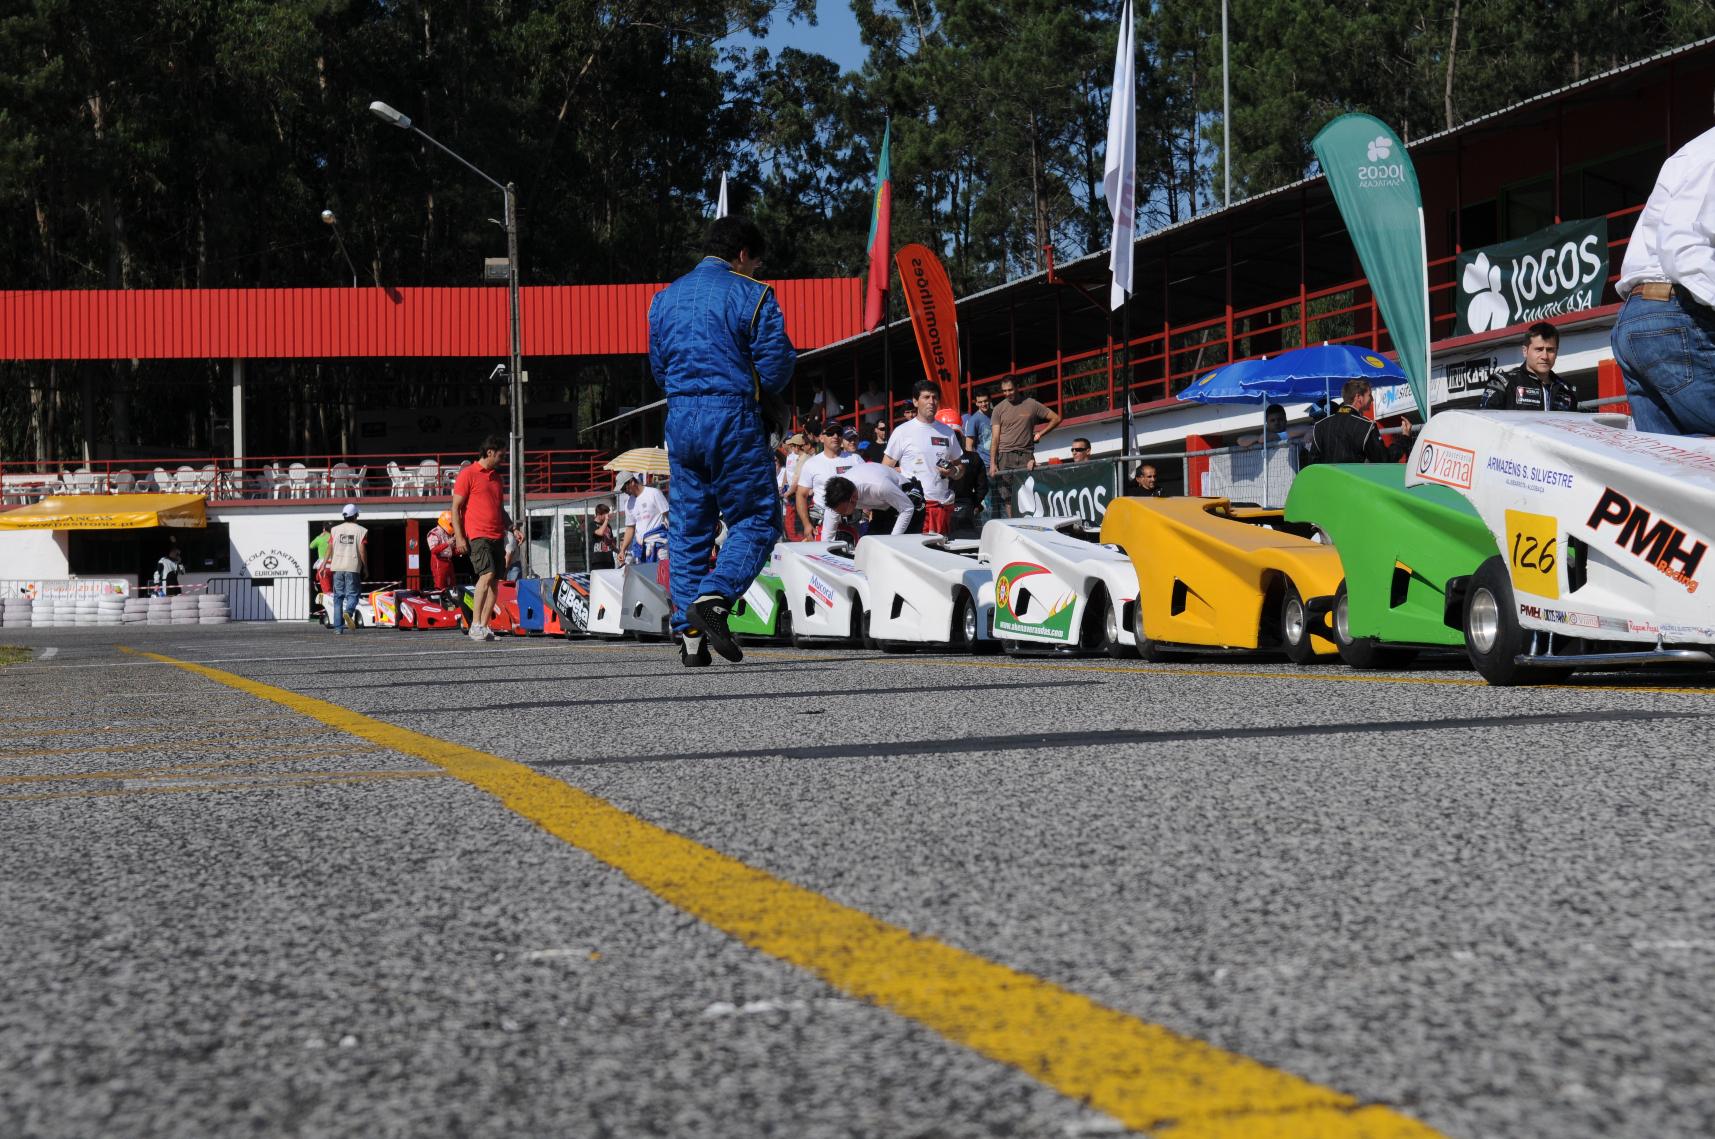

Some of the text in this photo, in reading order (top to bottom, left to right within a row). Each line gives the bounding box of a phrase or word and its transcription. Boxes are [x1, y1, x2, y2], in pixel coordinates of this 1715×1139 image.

[1511, 234, 1601, 321] JOGOS
[1433, 448, 1470, 482] Viana
[1487, 456, 1521, 477] ARMAZÉNS
[1531, 467, 1574, 489] SILVESTRE
[1586, 486, 1709, 579] PMH
[270, 549, 304, 576] KARTING
[1513, 532, 1557, 574] 126
[809, 574, 834, 601] Mucoral
[1657, 560, 1699, 593] Racing
[1520, 604, 1541, 620] PMH
